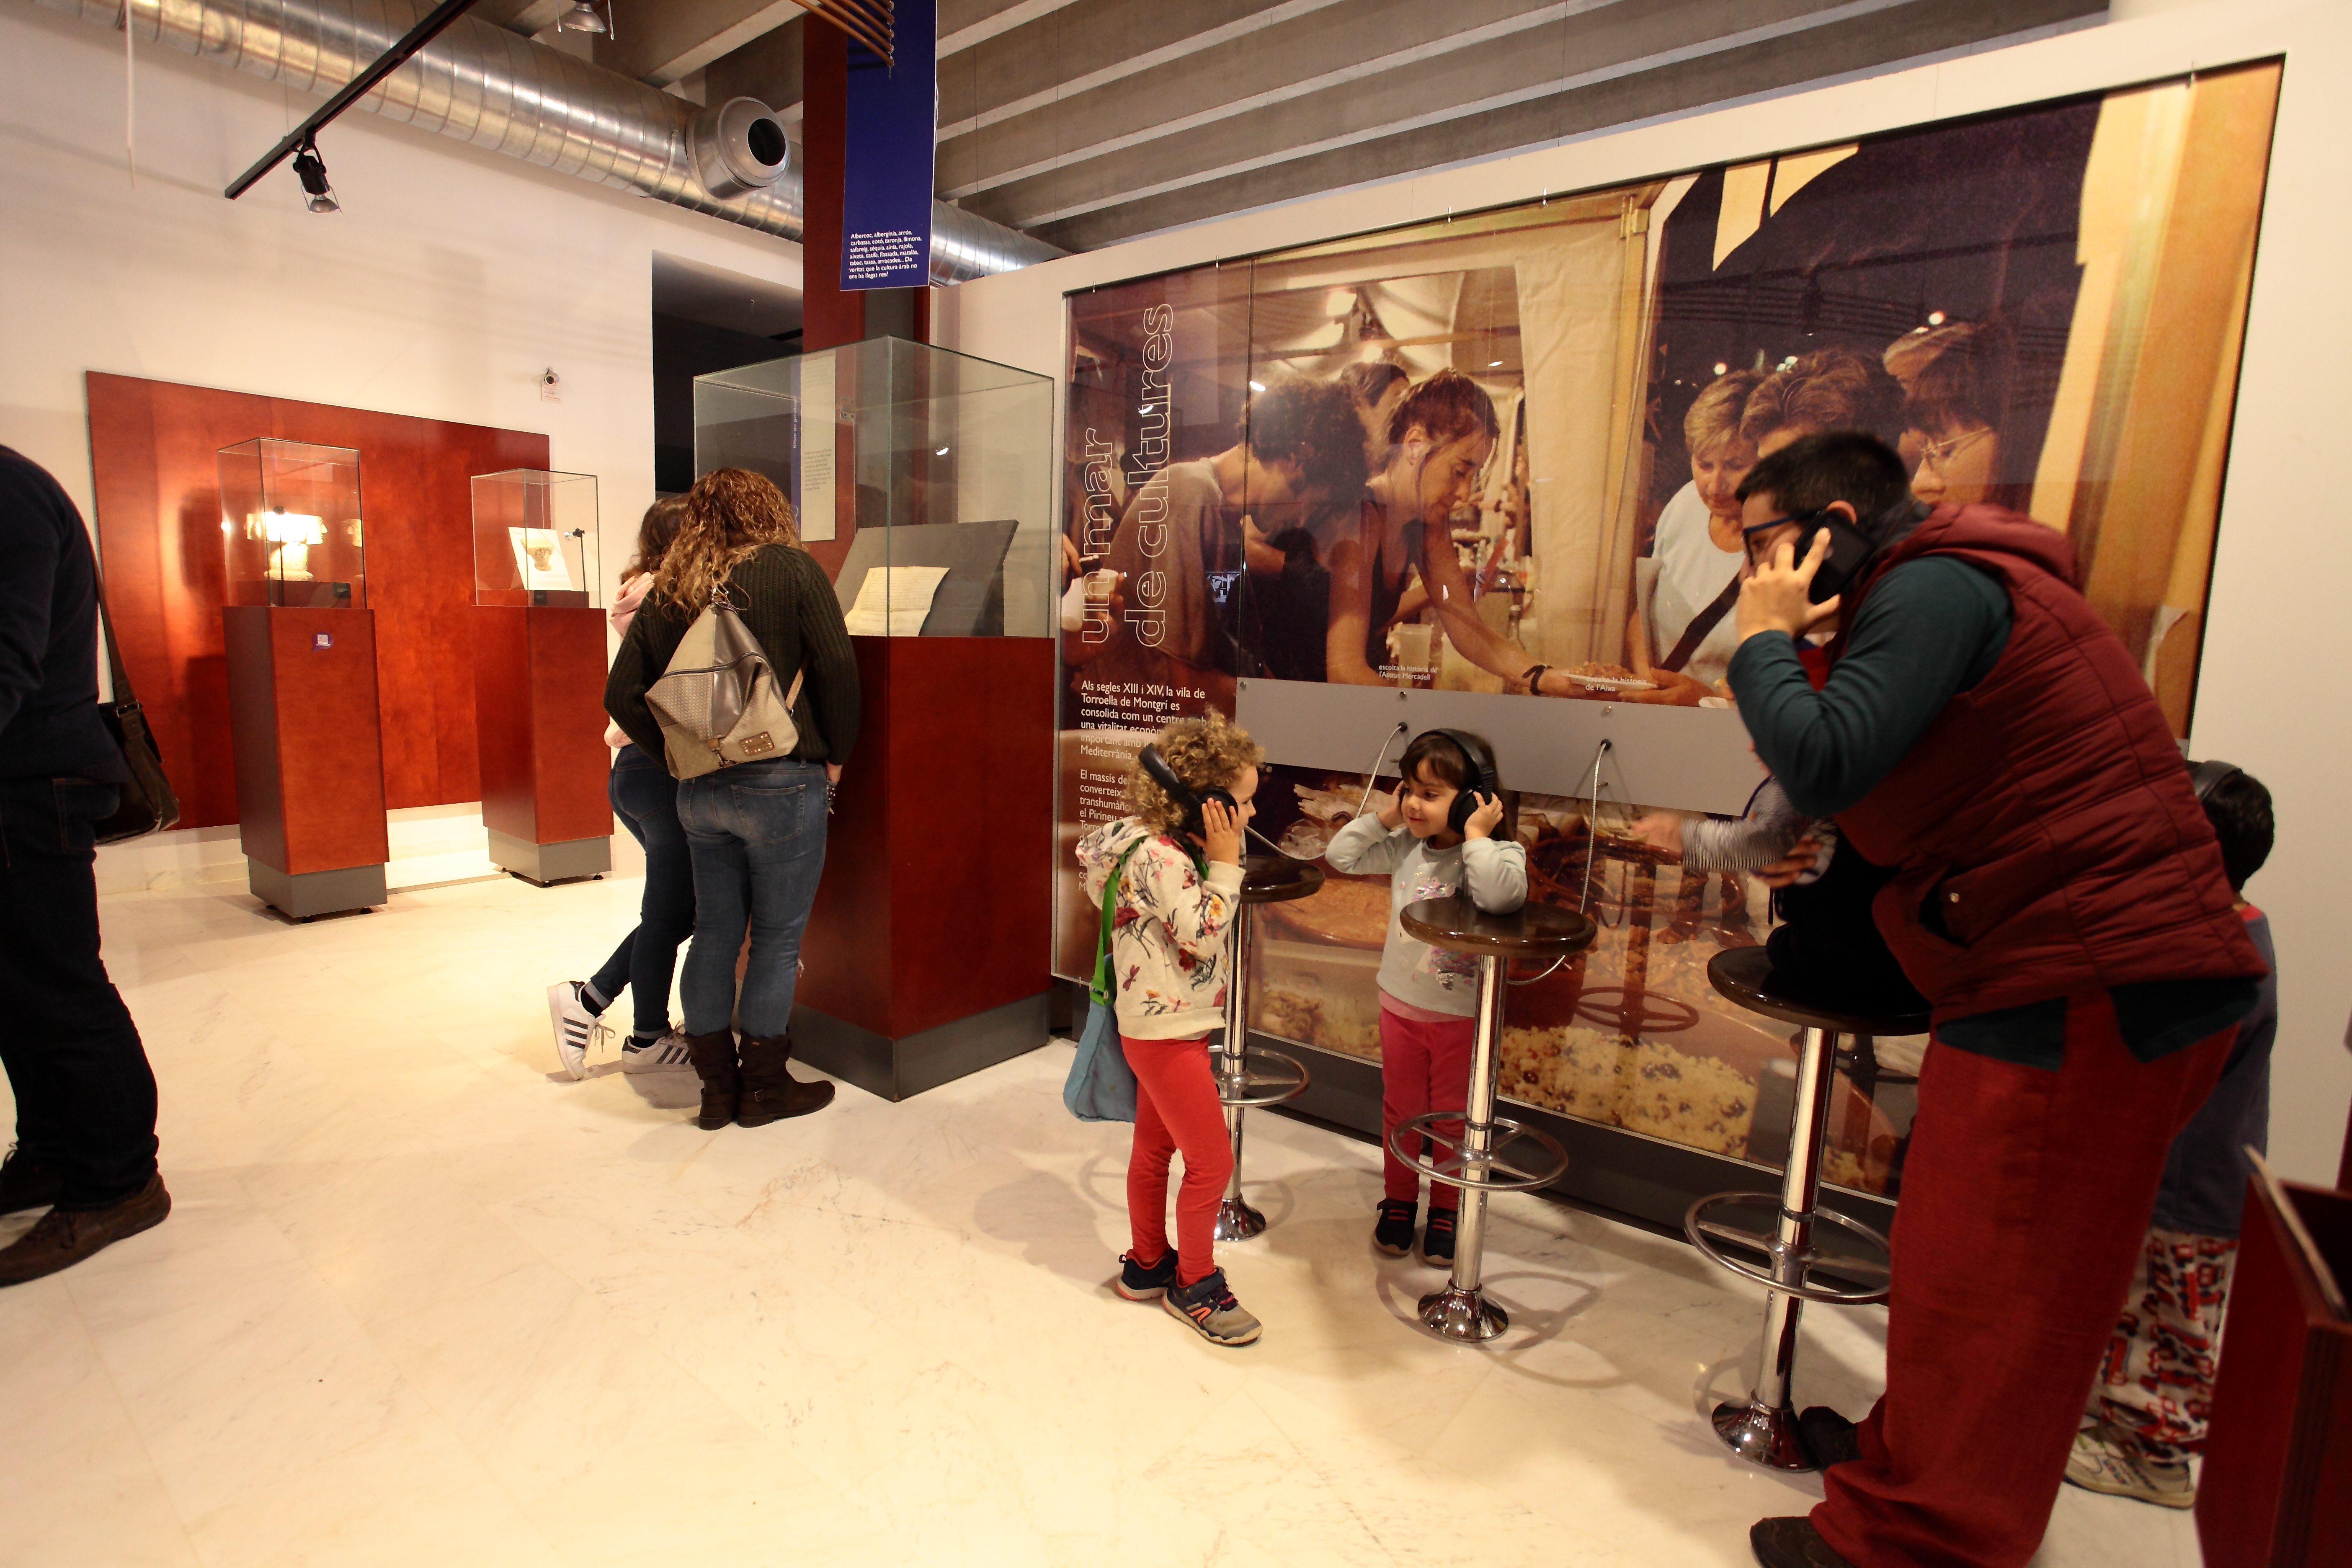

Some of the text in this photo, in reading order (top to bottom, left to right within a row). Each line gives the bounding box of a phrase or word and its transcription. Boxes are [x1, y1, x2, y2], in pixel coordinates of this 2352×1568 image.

[1124, 304, 1173, 647] de cultures
[1083, 428, 1112, 643] un mar
[1081, 680, 1206, 699] Als segles XIII i XIV, la vila de
[1081, 693, 1180, 712] Torroella de Montgrí es
[1081, 707, 1119, 719] consolida
[1122, 712, 1140, 721] com
[1081, 721, 1164, 735] una vitalitat econòm
[1081, 735, 1121, 745] important
[1124, 737, 1141, 748] amb
[1081, 744, 1134, 760] Mediterrània.
[1081, 769, 1087, 779] El
[1090, 773, 1115, 784] massís
[1080, 784, 1122, 797] converteix
[1079, 807, 1117, 822] el Pirineu
